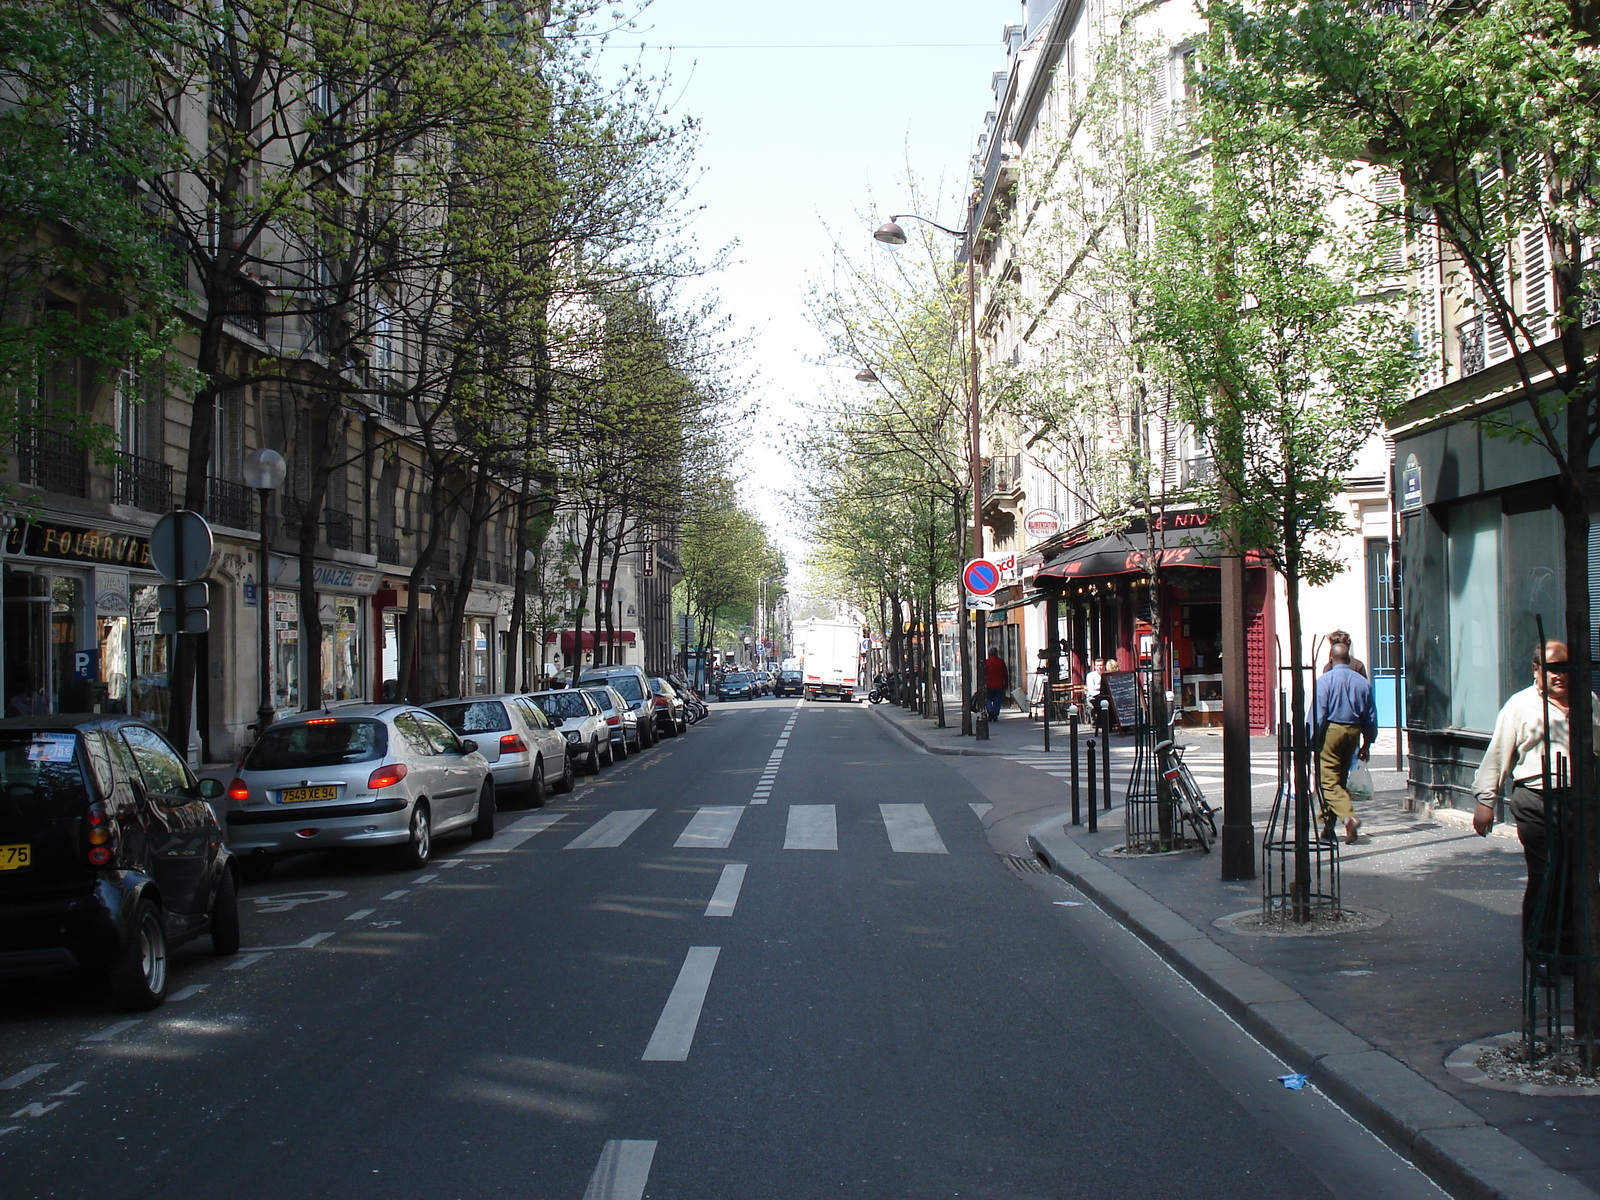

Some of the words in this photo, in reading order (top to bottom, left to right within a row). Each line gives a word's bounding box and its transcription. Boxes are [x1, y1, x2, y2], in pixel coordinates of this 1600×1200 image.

[1028, 521, 1057, 530] ALIMENTATION
[76, 652, 90, 671] P
[283, 789, 307, 801] 7549
[309, 788, 321, 799] XE
[322, 787, 335, 798] 94
[8, 847, 28, 863] 75
